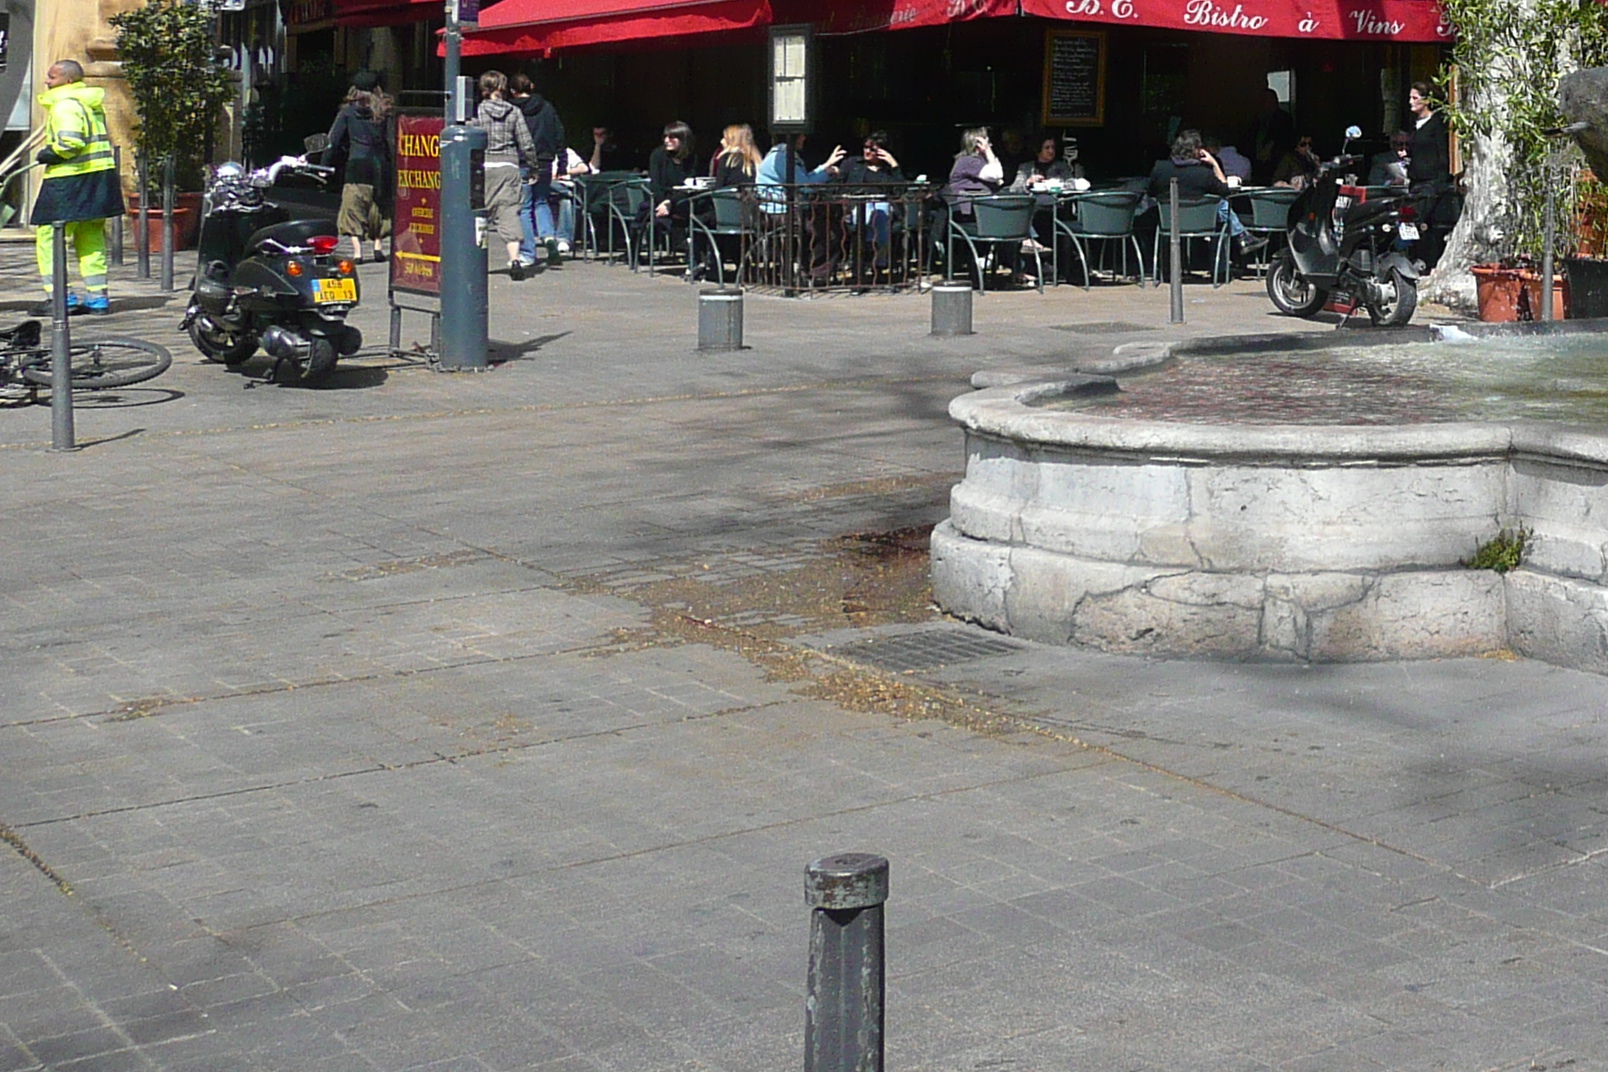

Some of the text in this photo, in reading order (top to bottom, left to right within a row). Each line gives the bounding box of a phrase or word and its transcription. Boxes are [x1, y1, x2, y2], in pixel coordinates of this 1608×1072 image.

[1298, 11, 1320, 33] à
[1349, 10, 1405, 35] Vins
[399, 135, 440, 157] CHANG
[398, 169, 441, 190] EXCHANG
